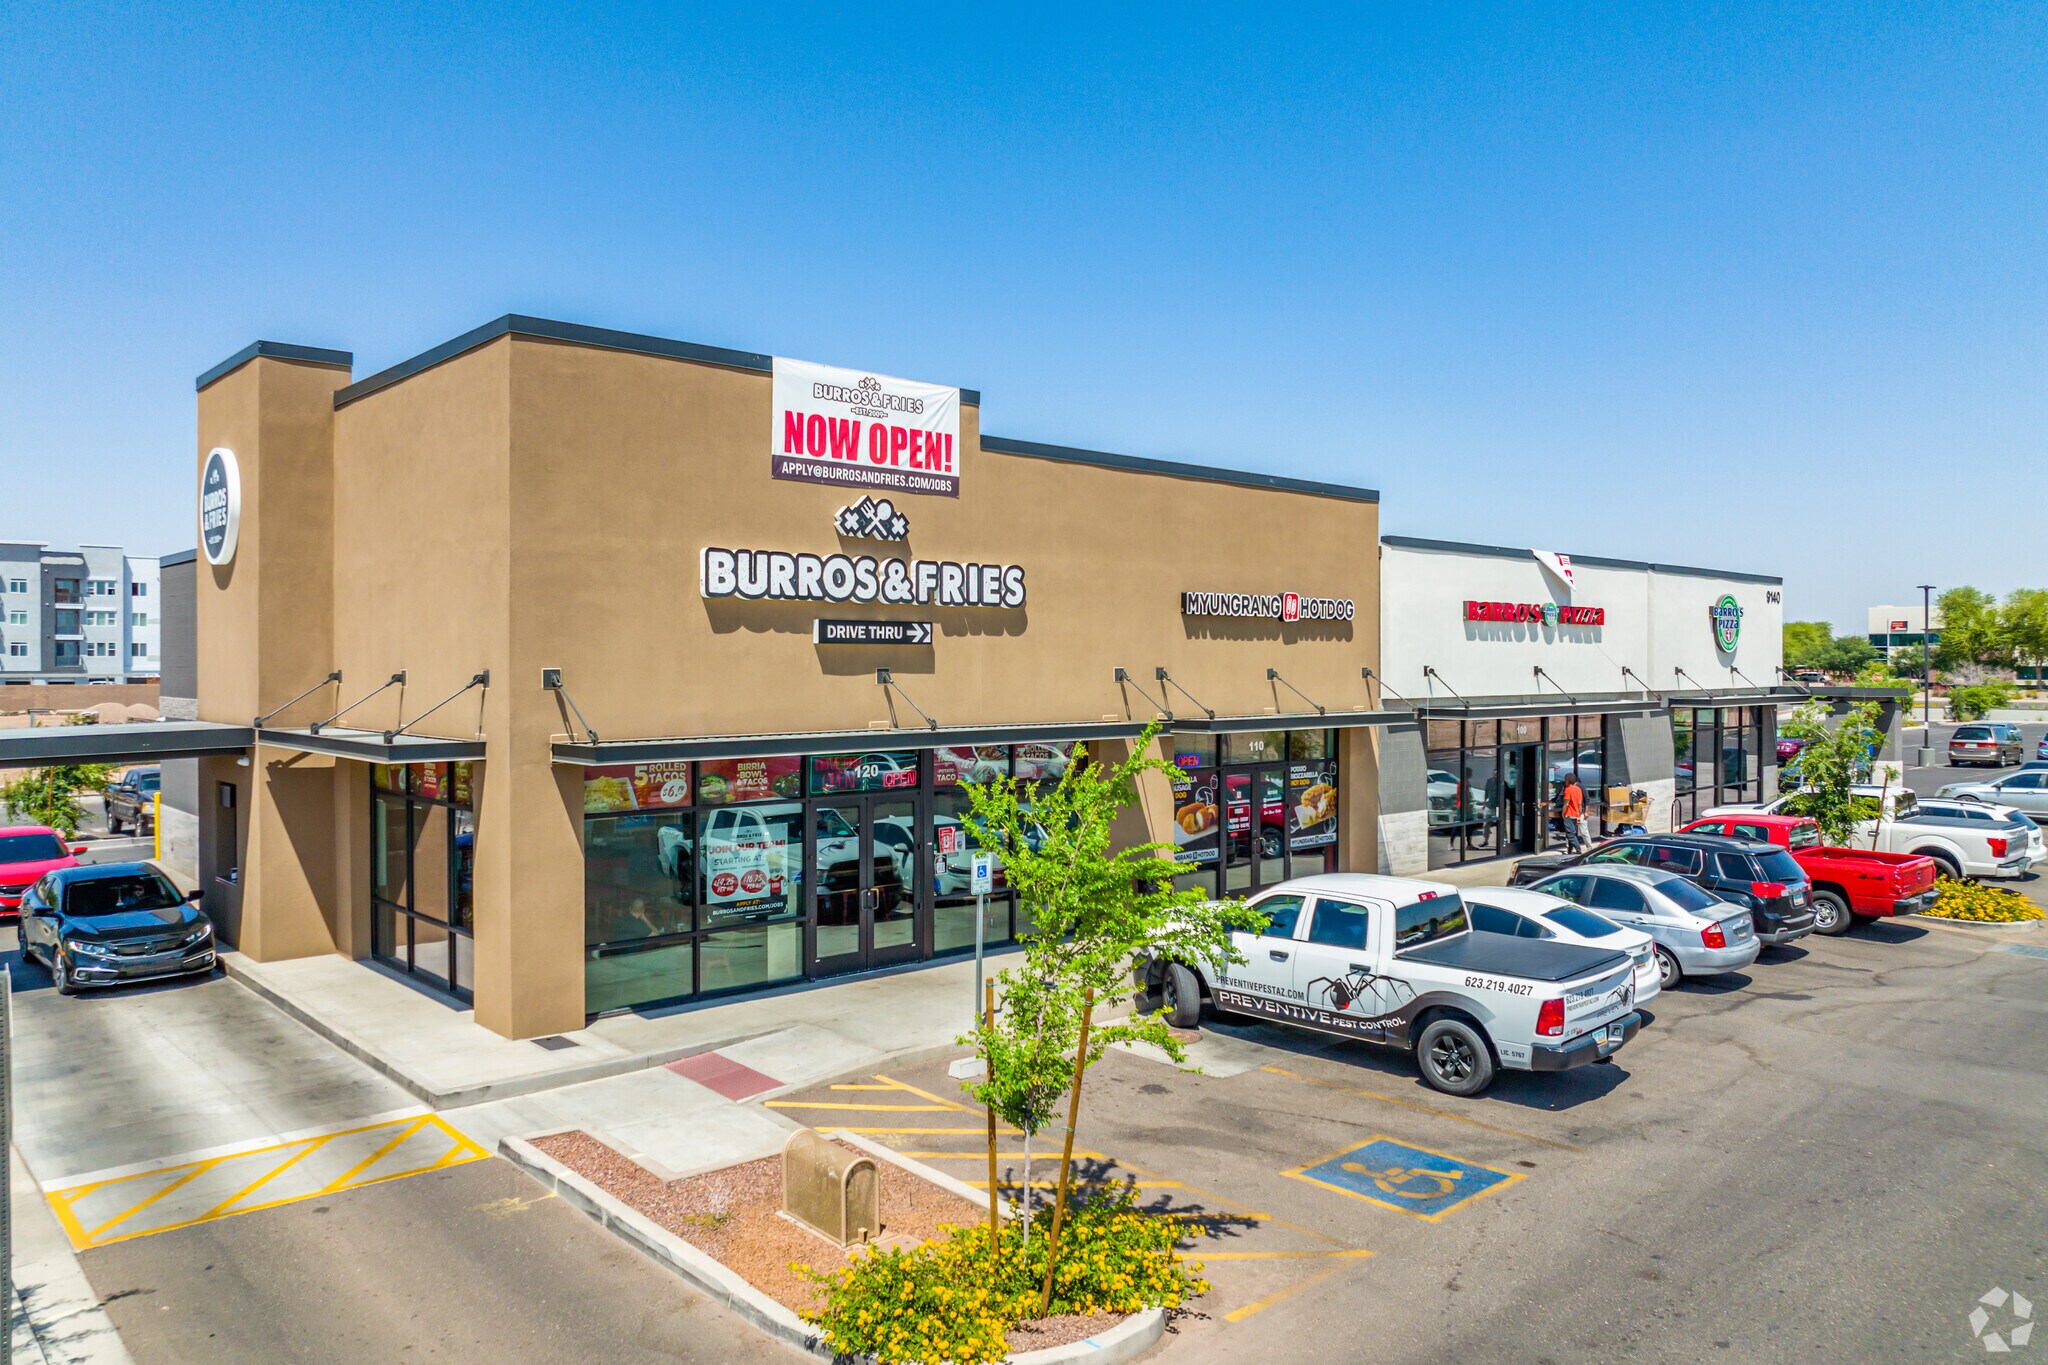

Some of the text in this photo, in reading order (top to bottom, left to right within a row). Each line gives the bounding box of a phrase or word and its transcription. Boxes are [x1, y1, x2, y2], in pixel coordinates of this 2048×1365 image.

[813, 382, 924, 415] BURROS&FRIES
[784, 409, 953, 473] NOW OPEN!
[782, 461, 952, 492] APPLY@BURROSANDFRIES.COM/JOBS
[702, 548, 1027, 608] BURROS&FRIES
[1766, 590, 1781, 605] 9140
[1187, 592, 1355, 621] MYUNGRANG HOTDOG
[826, 623, 903, 640] DRIVE THRU
[1248, 740, 1265, 752] 110
[737, 762, 767, 771] BIRRIA
[1177, 755, 1199, 767] OPEN
[634, 762, 687, 786] 5 ROLLED
[739, 770, 765, 779] BOWL
[855, 764, 879, 778] 120
[884, 771, 915, 786] OPEN
[937, 773, 956, 782] TACO
[742, 777, 768, 786] TACOS
[1175, 791, 1187, 799] DOG
[709, 844, 732, 855] JOIN
[713, 855, 752, 866] STARTING
[1216, 975, 1305, 1001] PREVENTIVEPESTAZ.COM
[1465, 976, 1534, 997] 623.219.4027
[1219, 990, 1407, 1030] PREVENTIVE PEST CONTROL
